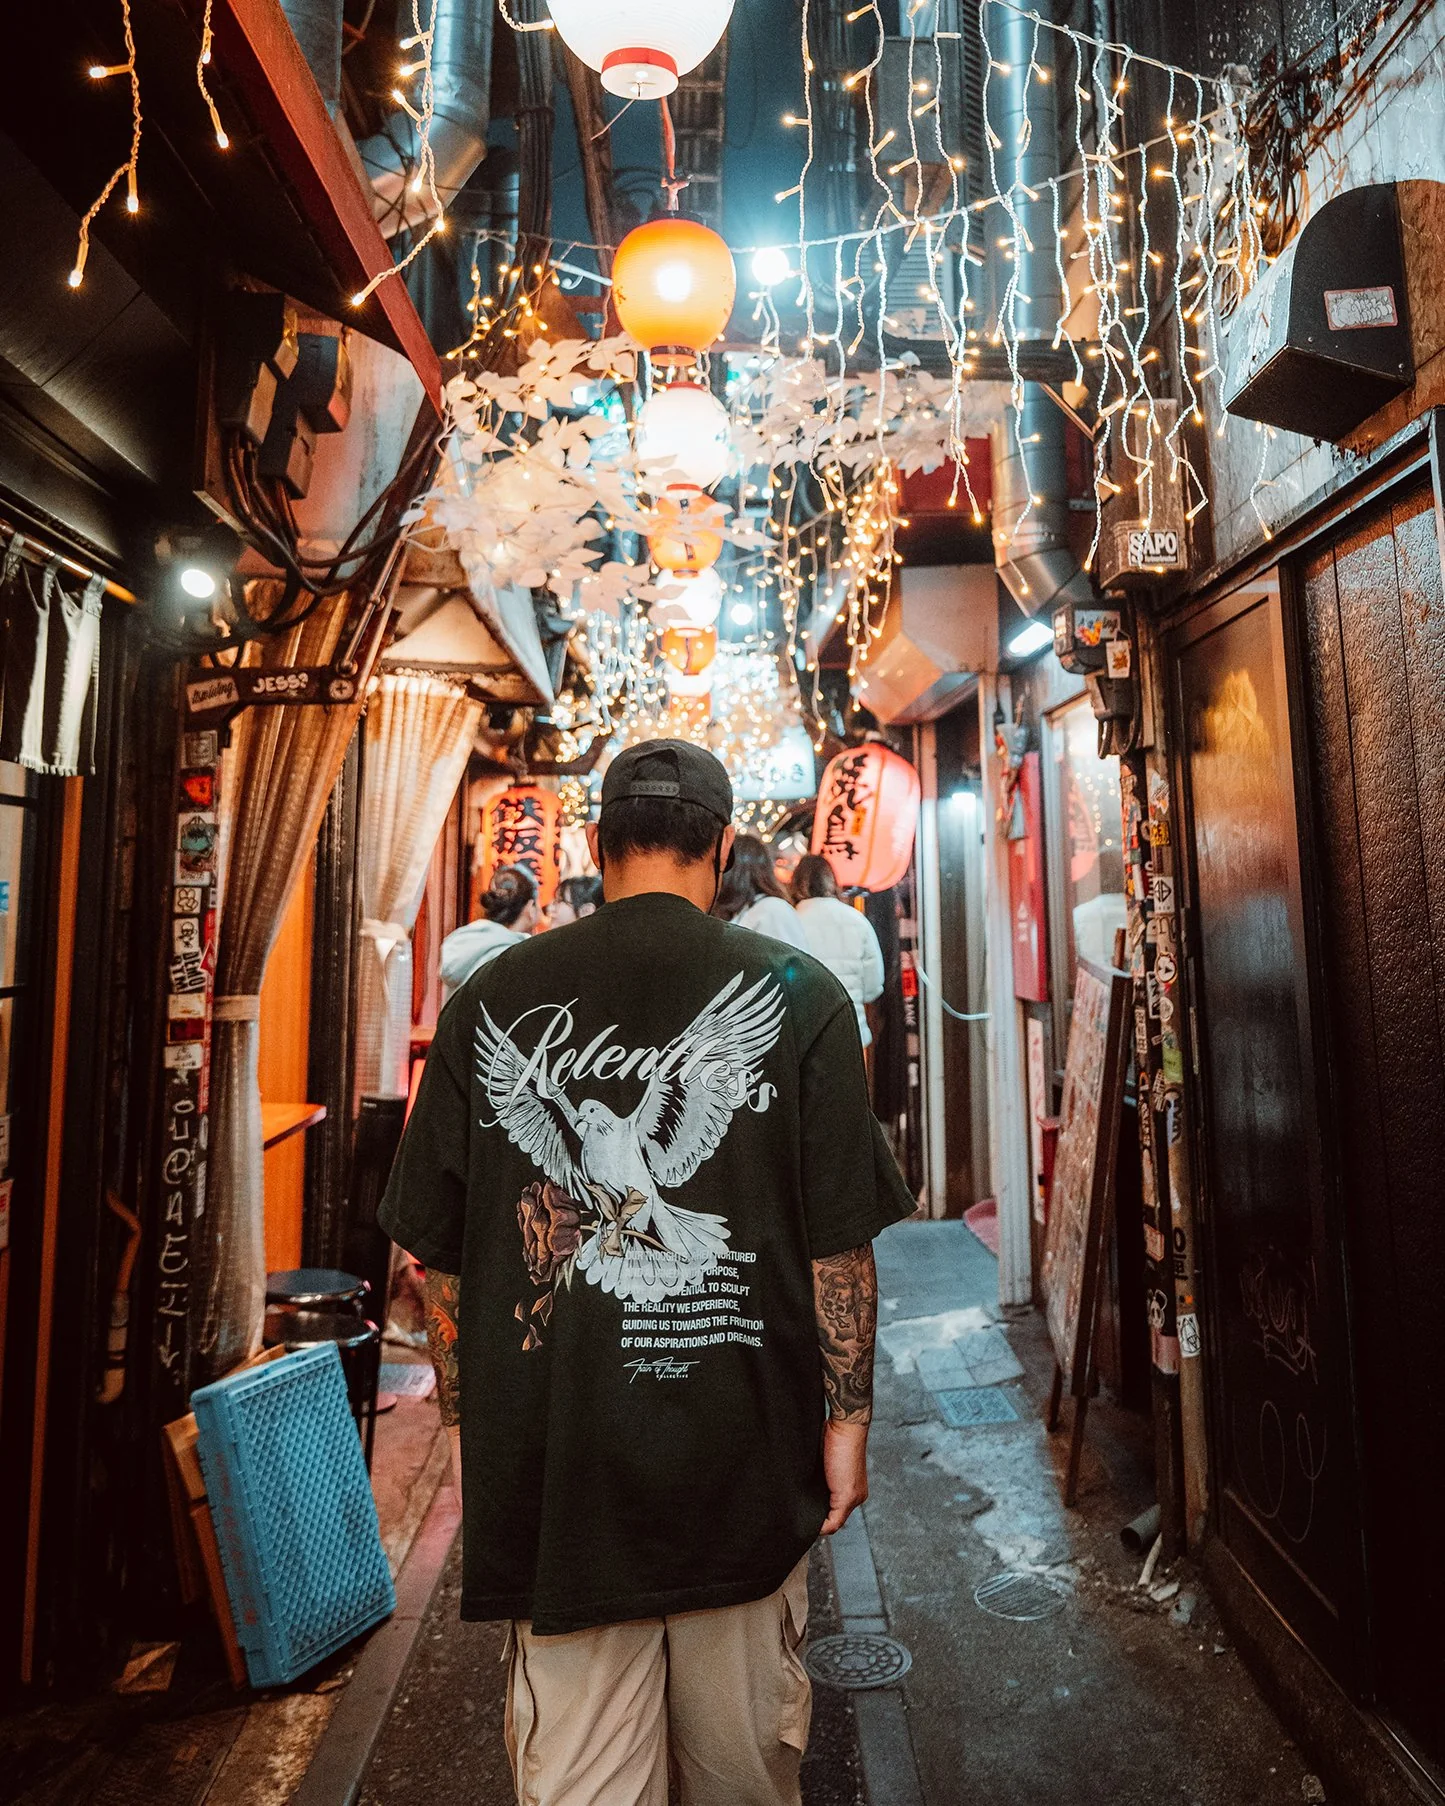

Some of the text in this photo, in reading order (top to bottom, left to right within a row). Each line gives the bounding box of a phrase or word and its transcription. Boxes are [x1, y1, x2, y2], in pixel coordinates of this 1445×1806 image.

[479, 998, 777, 1128] Relentless
[708, 1282, 719, 1293] TO
[720, 1282, 751, 1296] SCULPT
[623, 1299, 740, 1314] THE REALITY WE EXPERIENCE,
[622, 1315, 765, 1331] GUIDING US TOWARDS THE FRUITION
[621, 1331, 763, 1349] OF OUR ASPIRATIONS AND DREAMS.
[652, 1356, 700, 1381] Thought
